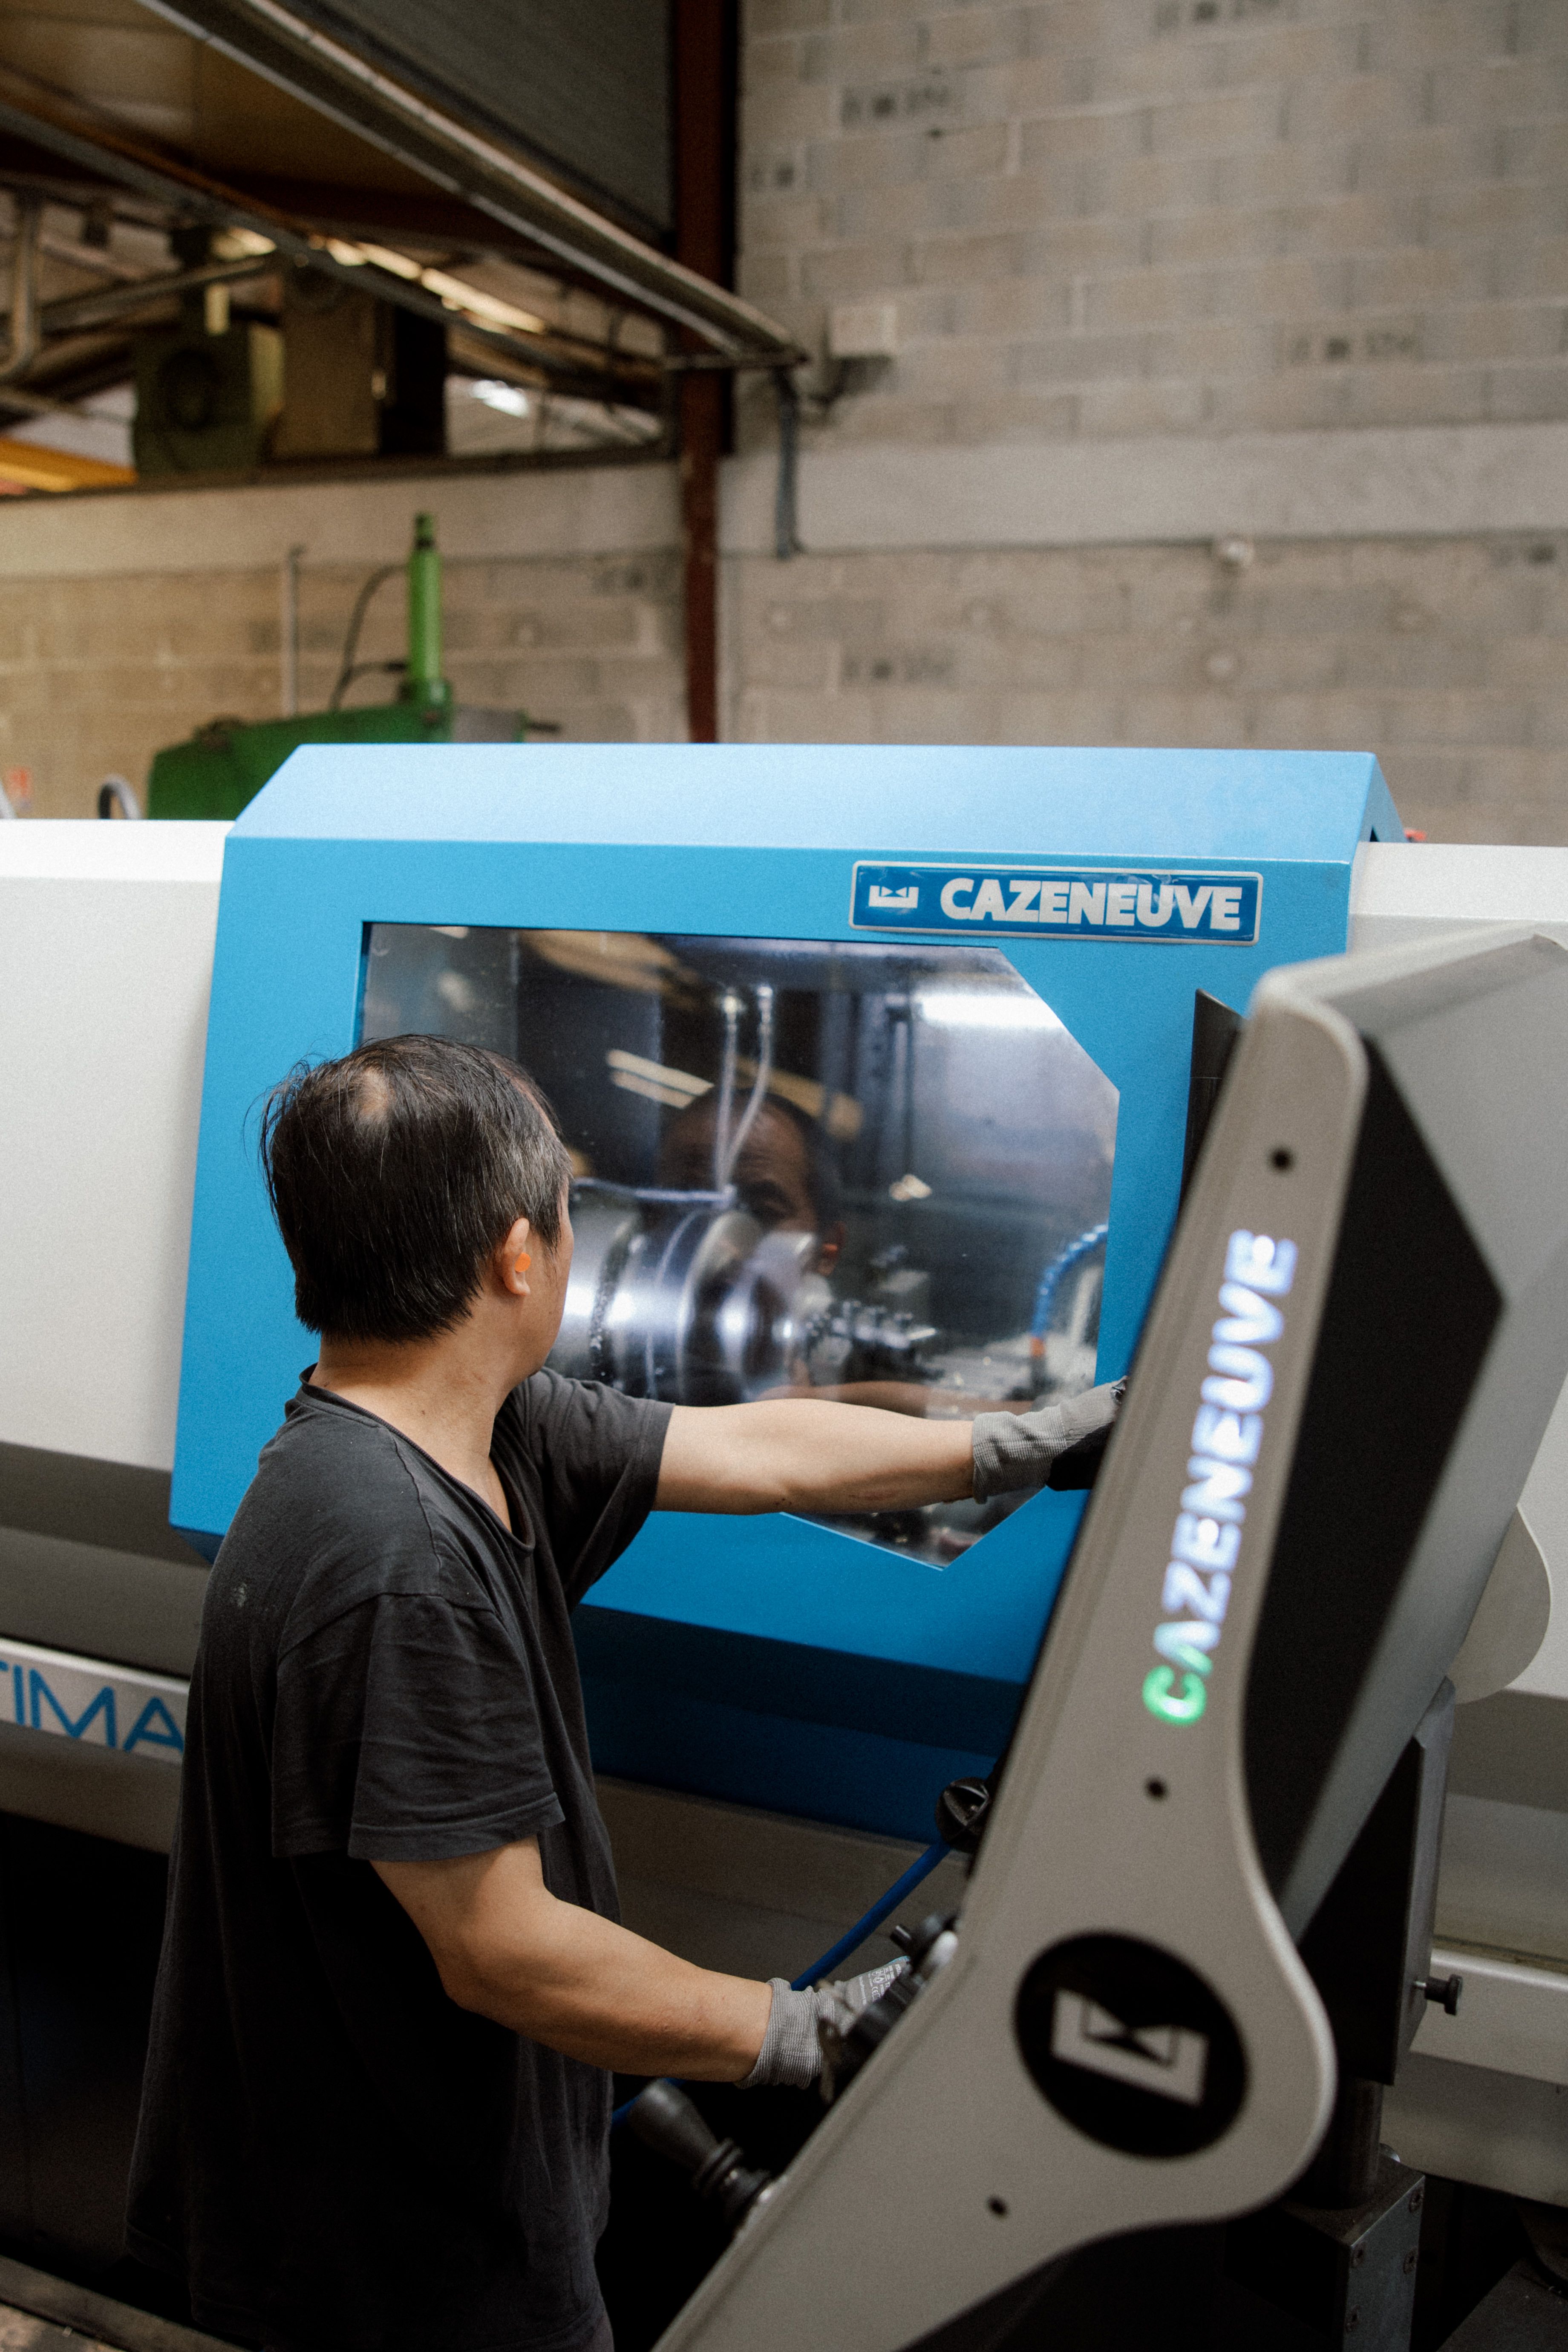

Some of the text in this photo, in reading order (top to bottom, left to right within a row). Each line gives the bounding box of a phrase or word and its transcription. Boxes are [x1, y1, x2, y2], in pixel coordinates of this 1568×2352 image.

[940, 877, 1242, 931] CAZENEUVE
[1142, 1229, 1298, 1727] CAZENEUVE
[0, 1660, 185, 1754] IMA
